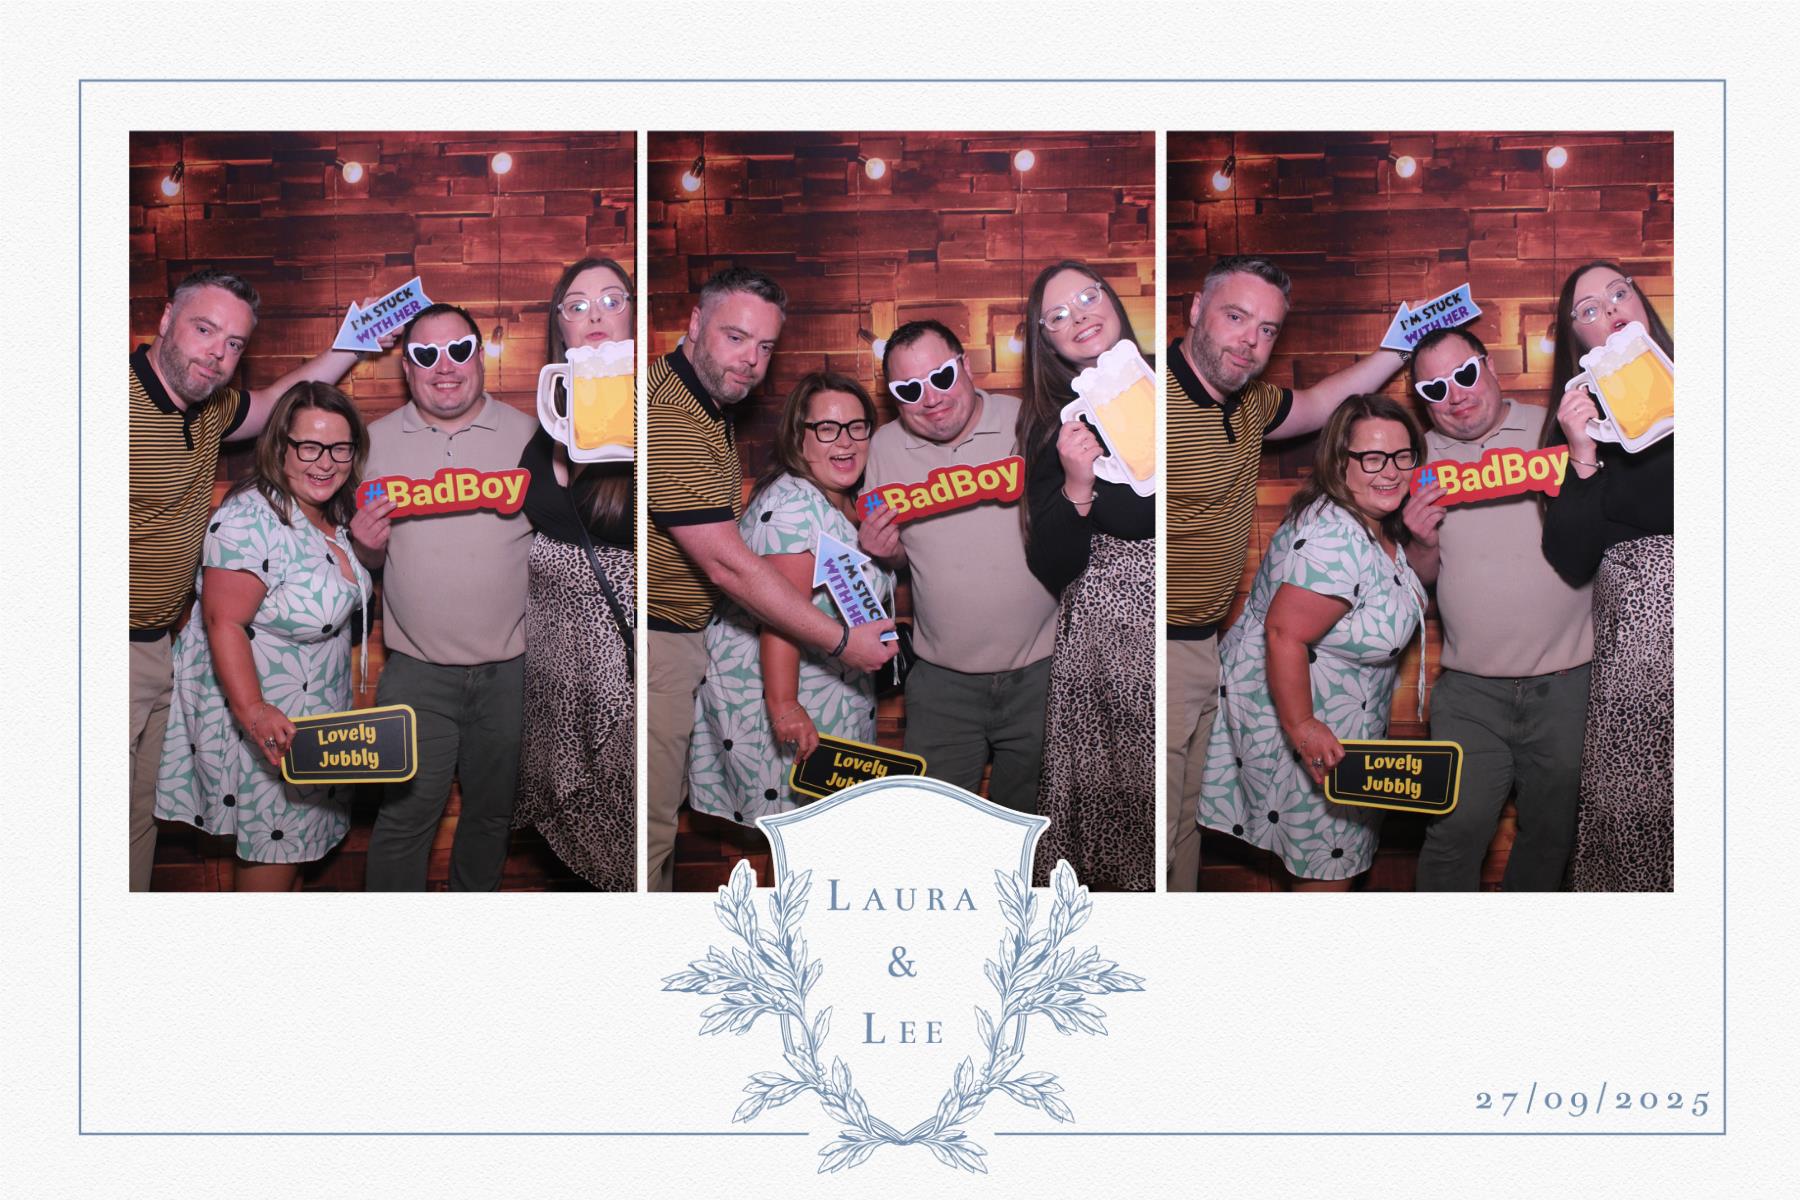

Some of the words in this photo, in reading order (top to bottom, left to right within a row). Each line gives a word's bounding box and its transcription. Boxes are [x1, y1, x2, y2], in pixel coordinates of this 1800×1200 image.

[351, 312, 373, 331] I'M
[373, 287, 414, 318] STUCK
[356, 316, 394, 344] WITH
[394, 300, 421, 323] HER
[1400, 314, 1422, 331] I'M
[1422, 293, 1462, 319] STUCK
[1404, 319, 1442, 344] WITH
[1442, 305, 1469, 326] HER
[364, 473, 525, 508] #BadBoy
[864, 462, 1018, 515] #BadBoy
[1417, 451, 1569, 495] #BadBoy
[823, 558, 853, 604] WITH
[846, 604, 867, 627] HE
[838, 553, 858, 580] I'M
[853, 580, 883, 621] STUC
[318, 723, 377, 746] Lovely
[319, 748, 379, 770] Jubbly
[833, 752, 888, 778] Lovely
[1364, 754, 1423, 775] Lovely
[1362, 775, 1422, 799] Jubbly
